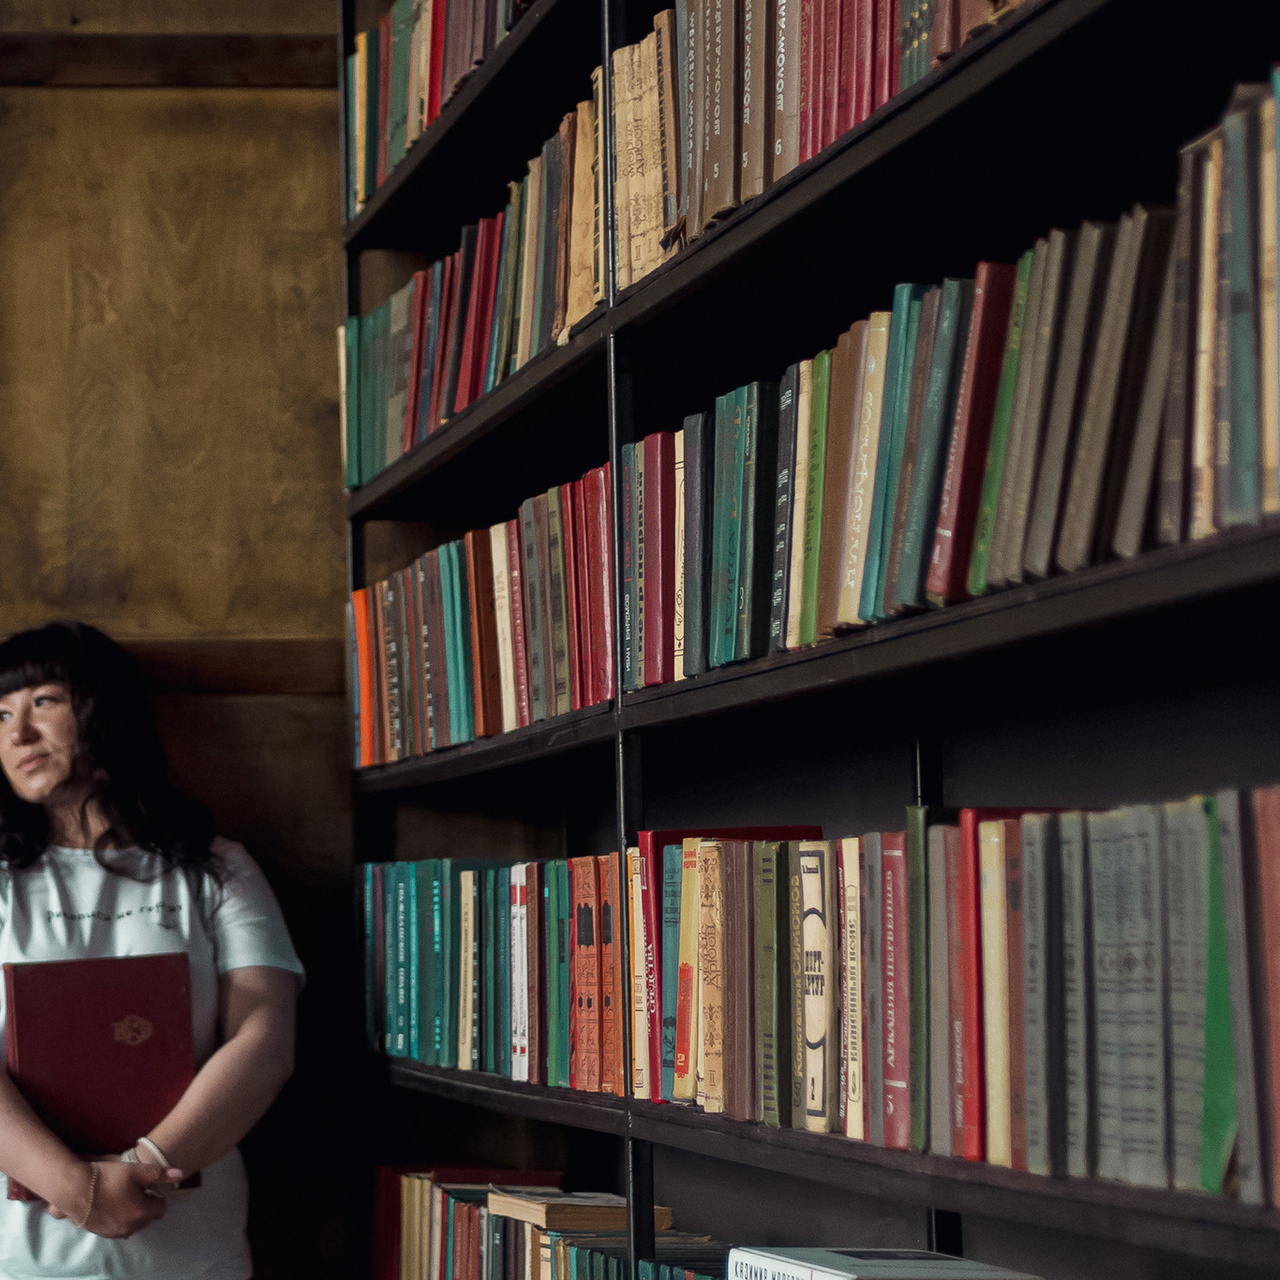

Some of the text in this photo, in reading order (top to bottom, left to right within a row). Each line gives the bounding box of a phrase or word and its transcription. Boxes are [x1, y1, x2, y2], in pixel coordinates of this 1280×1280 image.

[742, 151, 749, 168] 5
[775, 138, 782, 155] 6
[790, 874, 802, 977] СИМОНОВ
[647, 942, 656, 1015] СРЕДСТВА
[885, 982, 896, 1068] АРКАДИЙ
